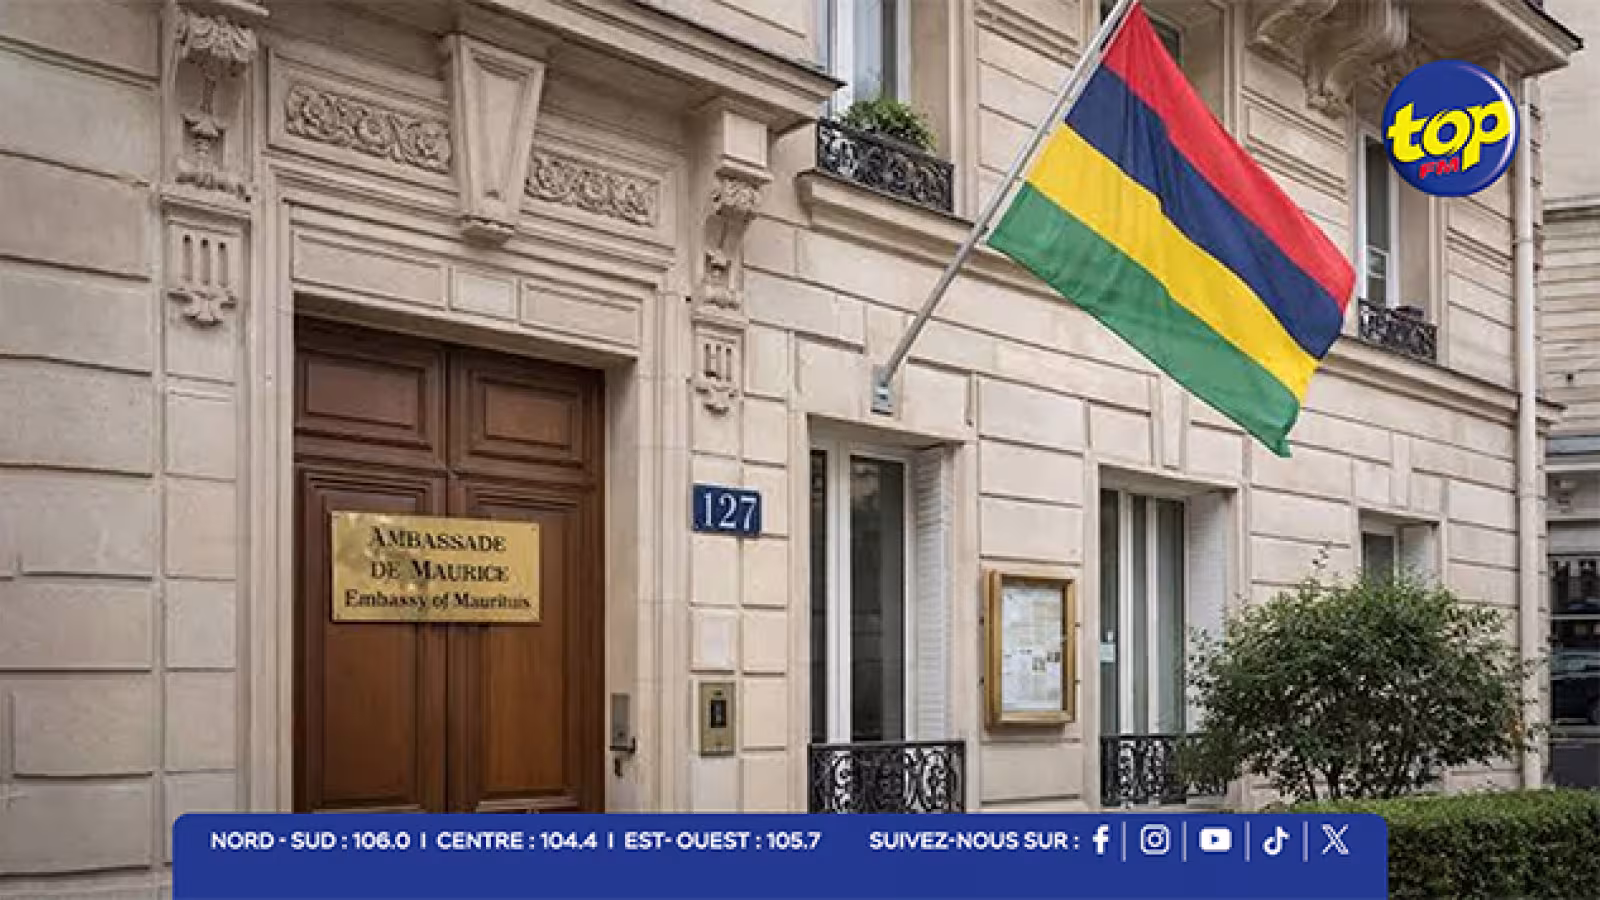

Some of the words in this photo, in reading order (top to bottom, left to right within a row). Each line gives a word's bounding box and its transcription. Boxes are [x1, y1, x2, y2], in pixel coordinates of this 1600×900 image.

[703, 491, 757, 532] 127
[367, 526, 507, 552] AMBASSADE
[371, 560, 400, 580] DE
[411, 559, 510, 583] MAURICE
[344, 588, 428, 612] Embassy
[432, 591, 448, 611] of
